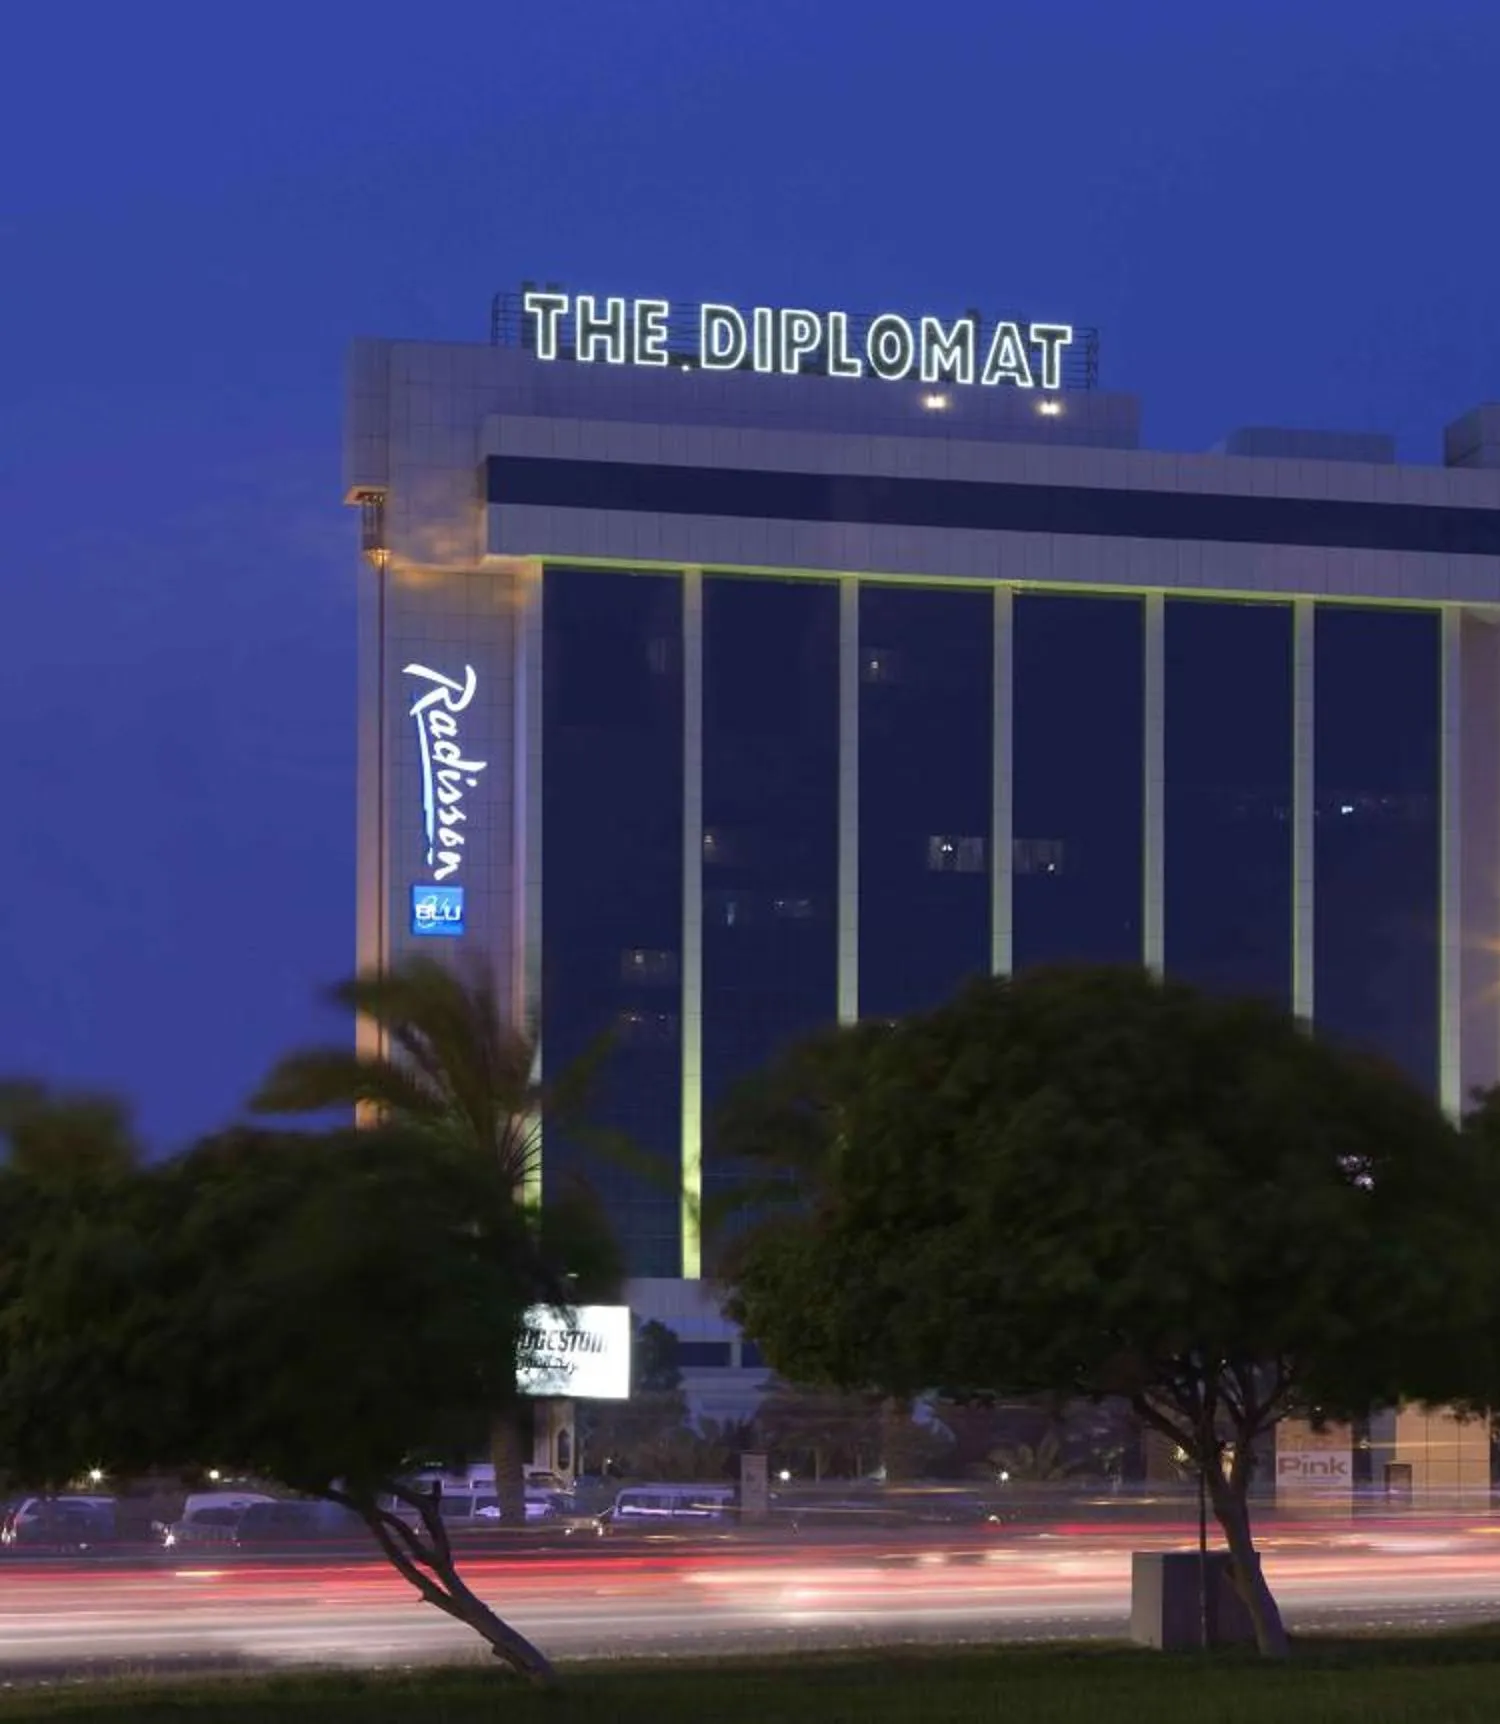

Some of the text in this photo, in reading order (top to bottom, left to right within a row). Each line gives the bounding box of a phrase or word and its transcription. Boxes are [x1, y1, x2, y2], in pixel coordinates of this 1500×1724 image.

[525, 292, 1072, 389] THE DIPLOMAT
[403, 664, 486, 880] Radisson
[1278, 1454, 1348, 1475] Pink
